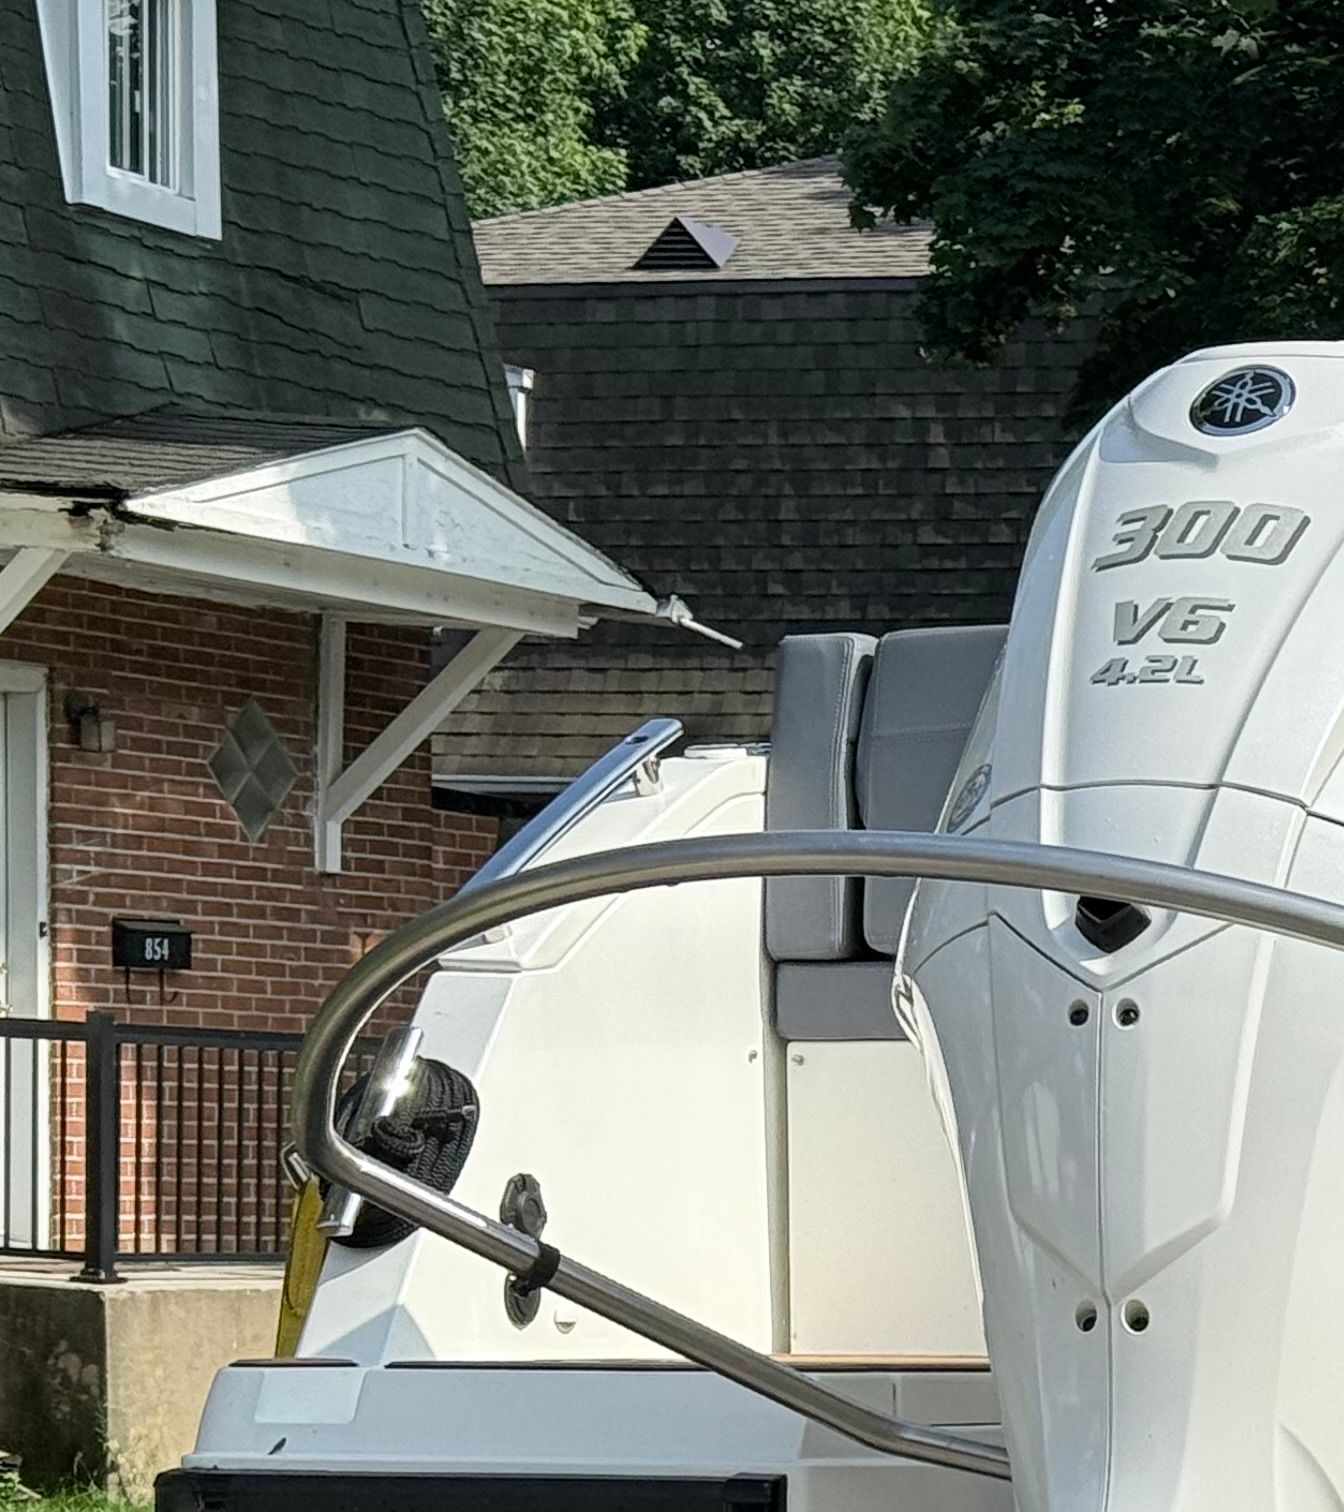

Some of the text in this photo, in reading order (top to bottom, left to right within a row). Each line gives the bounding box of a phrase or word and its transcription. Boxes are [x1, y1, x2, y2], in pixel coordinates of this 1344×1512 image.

[1091, 501, 1311, 572] 300
[1113, 597, 1236, 646] V6
[1091, 655, 1205, 686] 4.2L
[145, 937, 170, 960] 854
